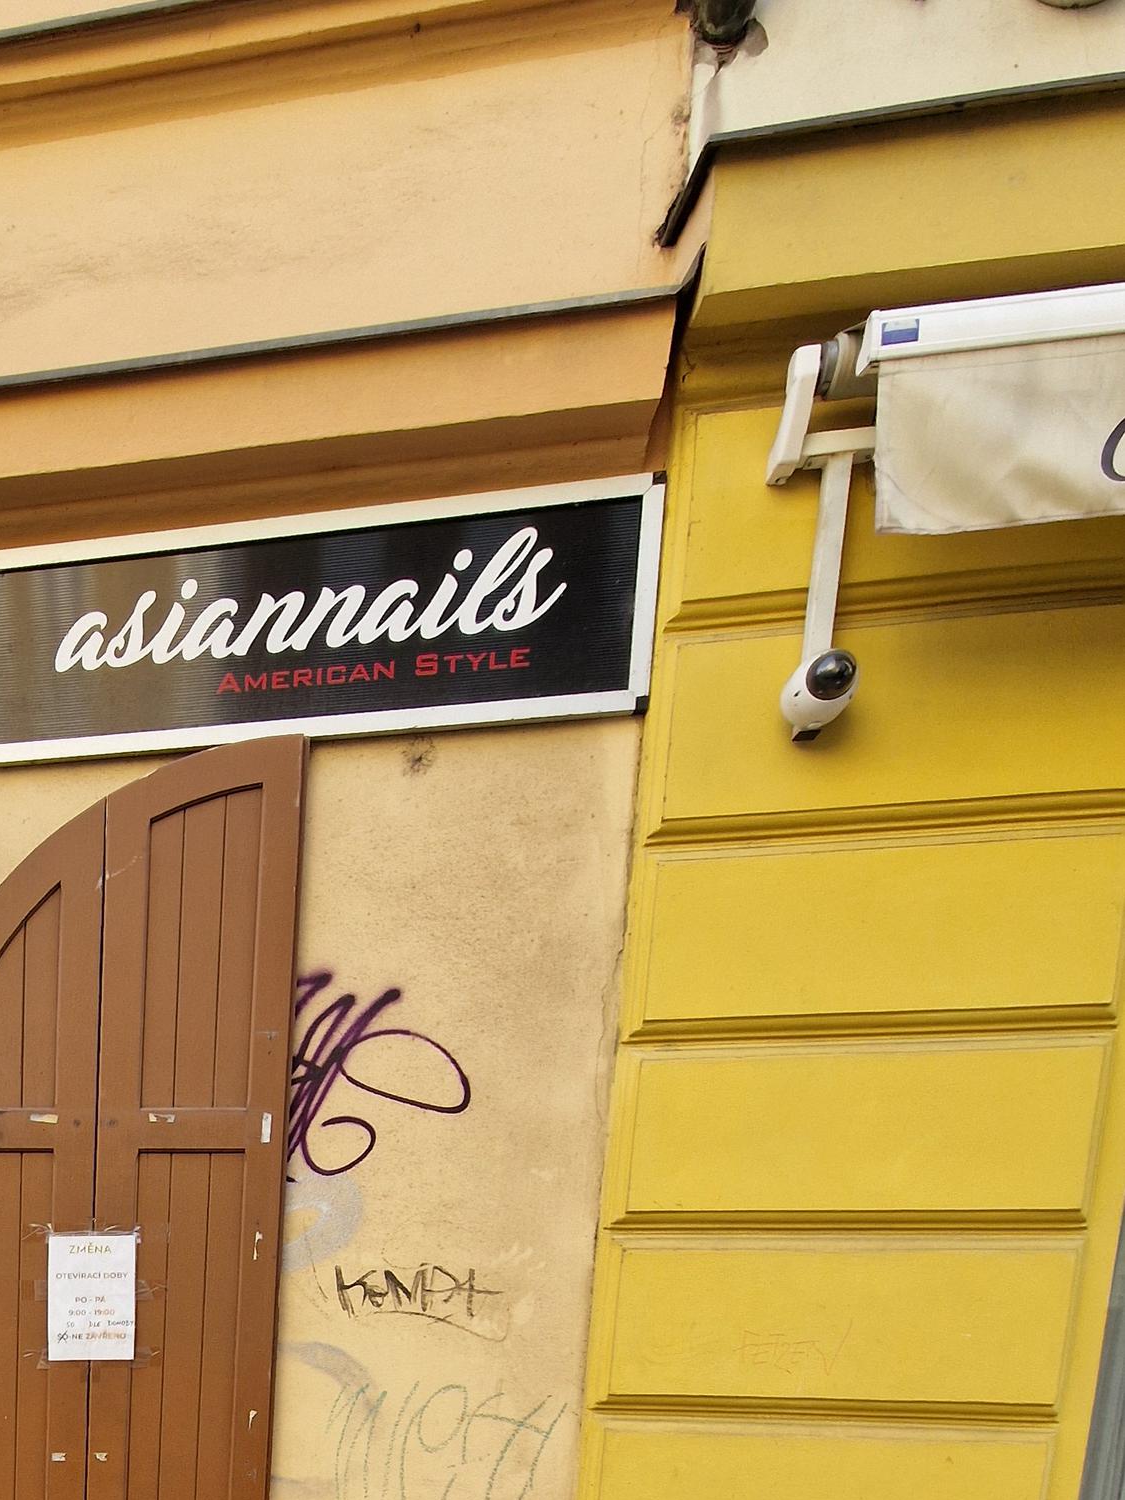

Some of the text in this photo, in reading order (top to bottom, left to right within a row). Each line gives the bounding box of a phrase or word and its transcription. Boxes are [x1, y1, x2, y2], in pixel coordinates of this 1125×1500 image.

[54, 526, 566, 673] asiannails
[216, 647, 531, 695] AMERICAN STYLE
[69, 1243, 111, 1254] ZMĚNA
